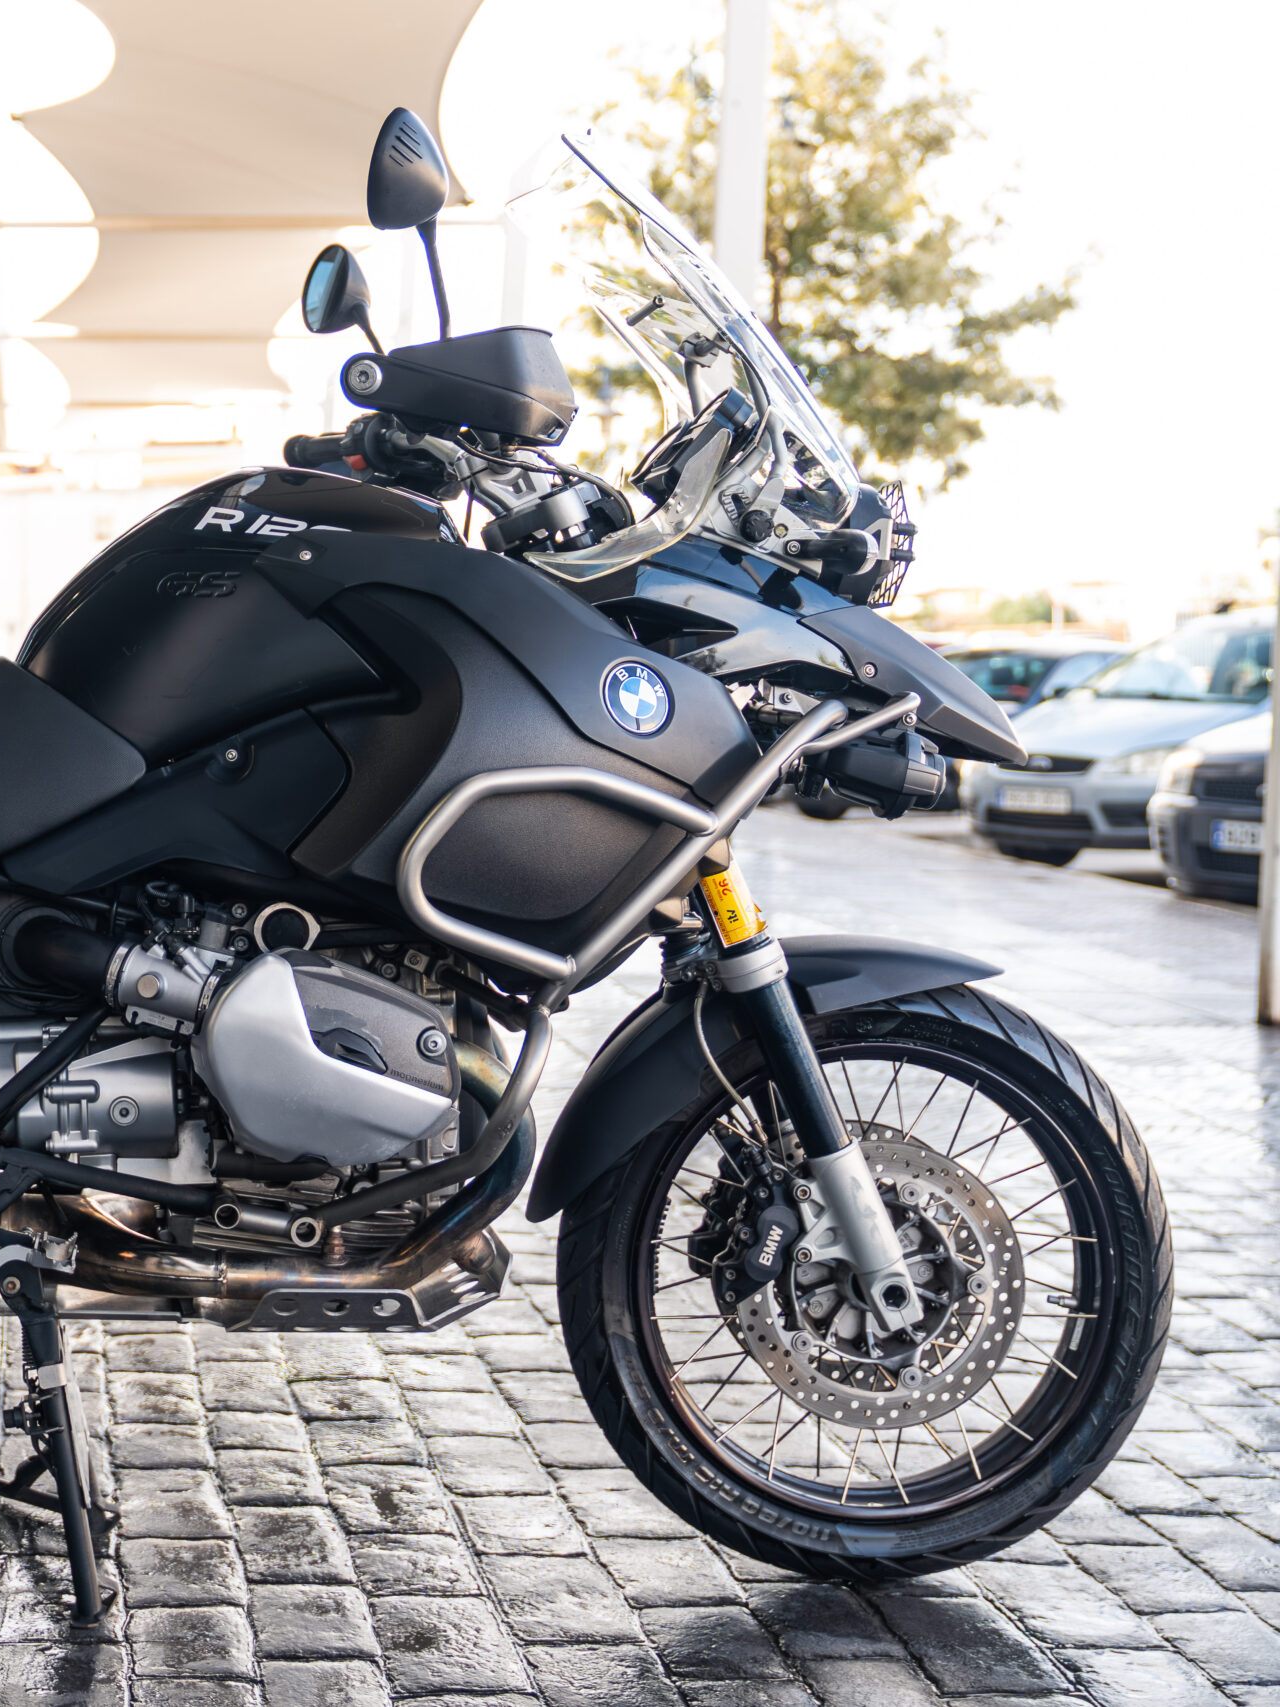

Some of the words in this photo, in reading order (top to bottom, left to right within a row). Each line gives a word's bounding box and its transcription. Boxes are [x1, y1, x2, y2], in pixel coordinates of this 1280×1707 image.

[193, 506, 244, 532] R
[244, 514, 352, 537] 12
[156, 571, 241, 597] GS
[615, 667, 665, 697] BMW
[390, 1069, 444, 1090] magnesium
[758, 1225, 784, 1266] BMW
